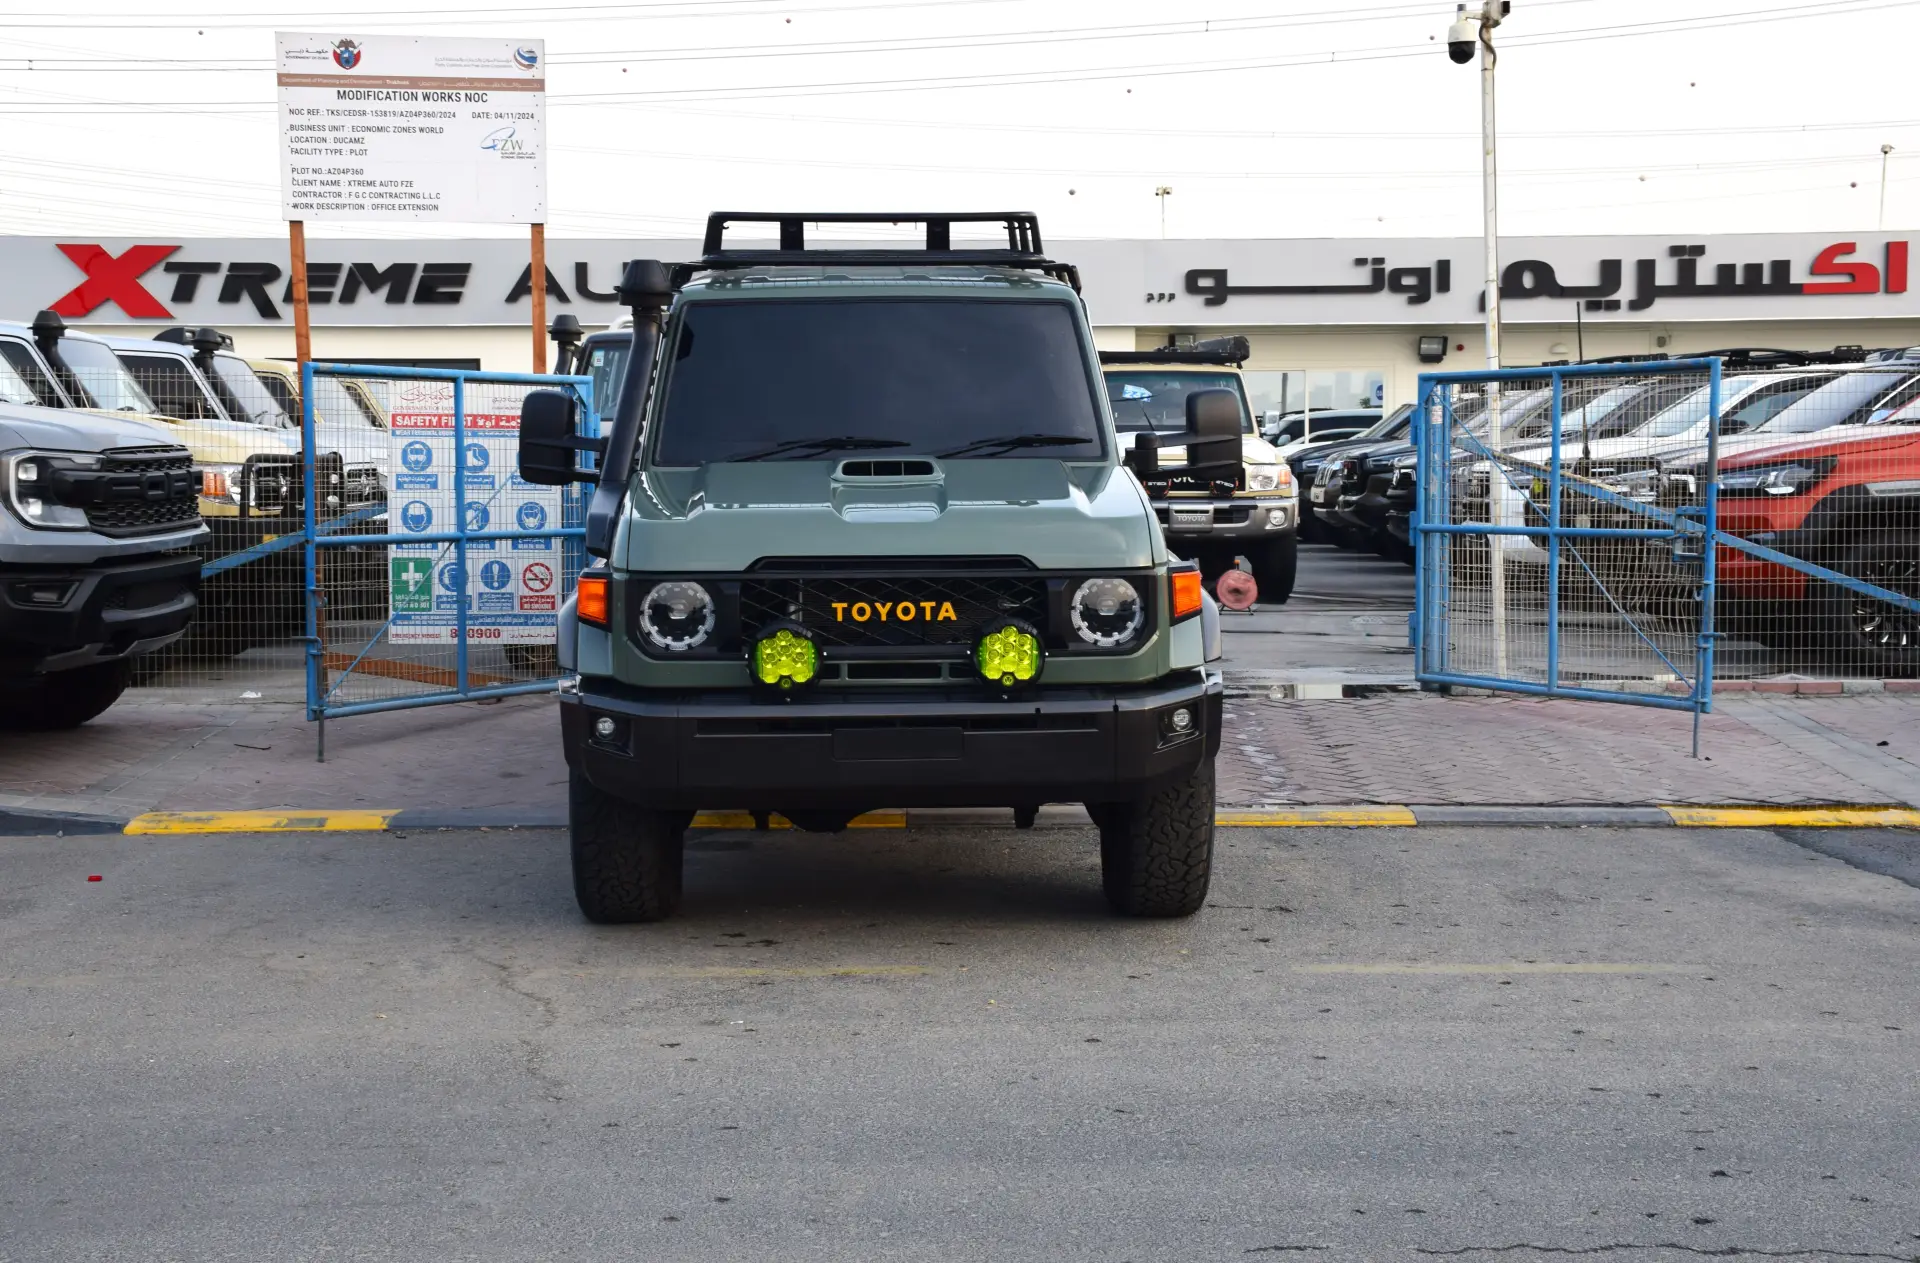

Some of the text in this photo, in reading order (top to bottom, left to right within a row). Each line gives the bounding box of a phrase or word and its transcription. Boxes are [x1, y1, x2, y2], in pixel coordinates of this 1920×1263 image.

[336, 90, 488, 103] MODIFICATION WORKS NOC
[292, 190, 342, 198] CONTRACTOR
[368, 192, 421, 200] CONTRACTING
[47, 244, 471, 319] XTREME
[396, 416, 438, 426] SAFETY
[832, 602, 958, 622] TOYOTA
